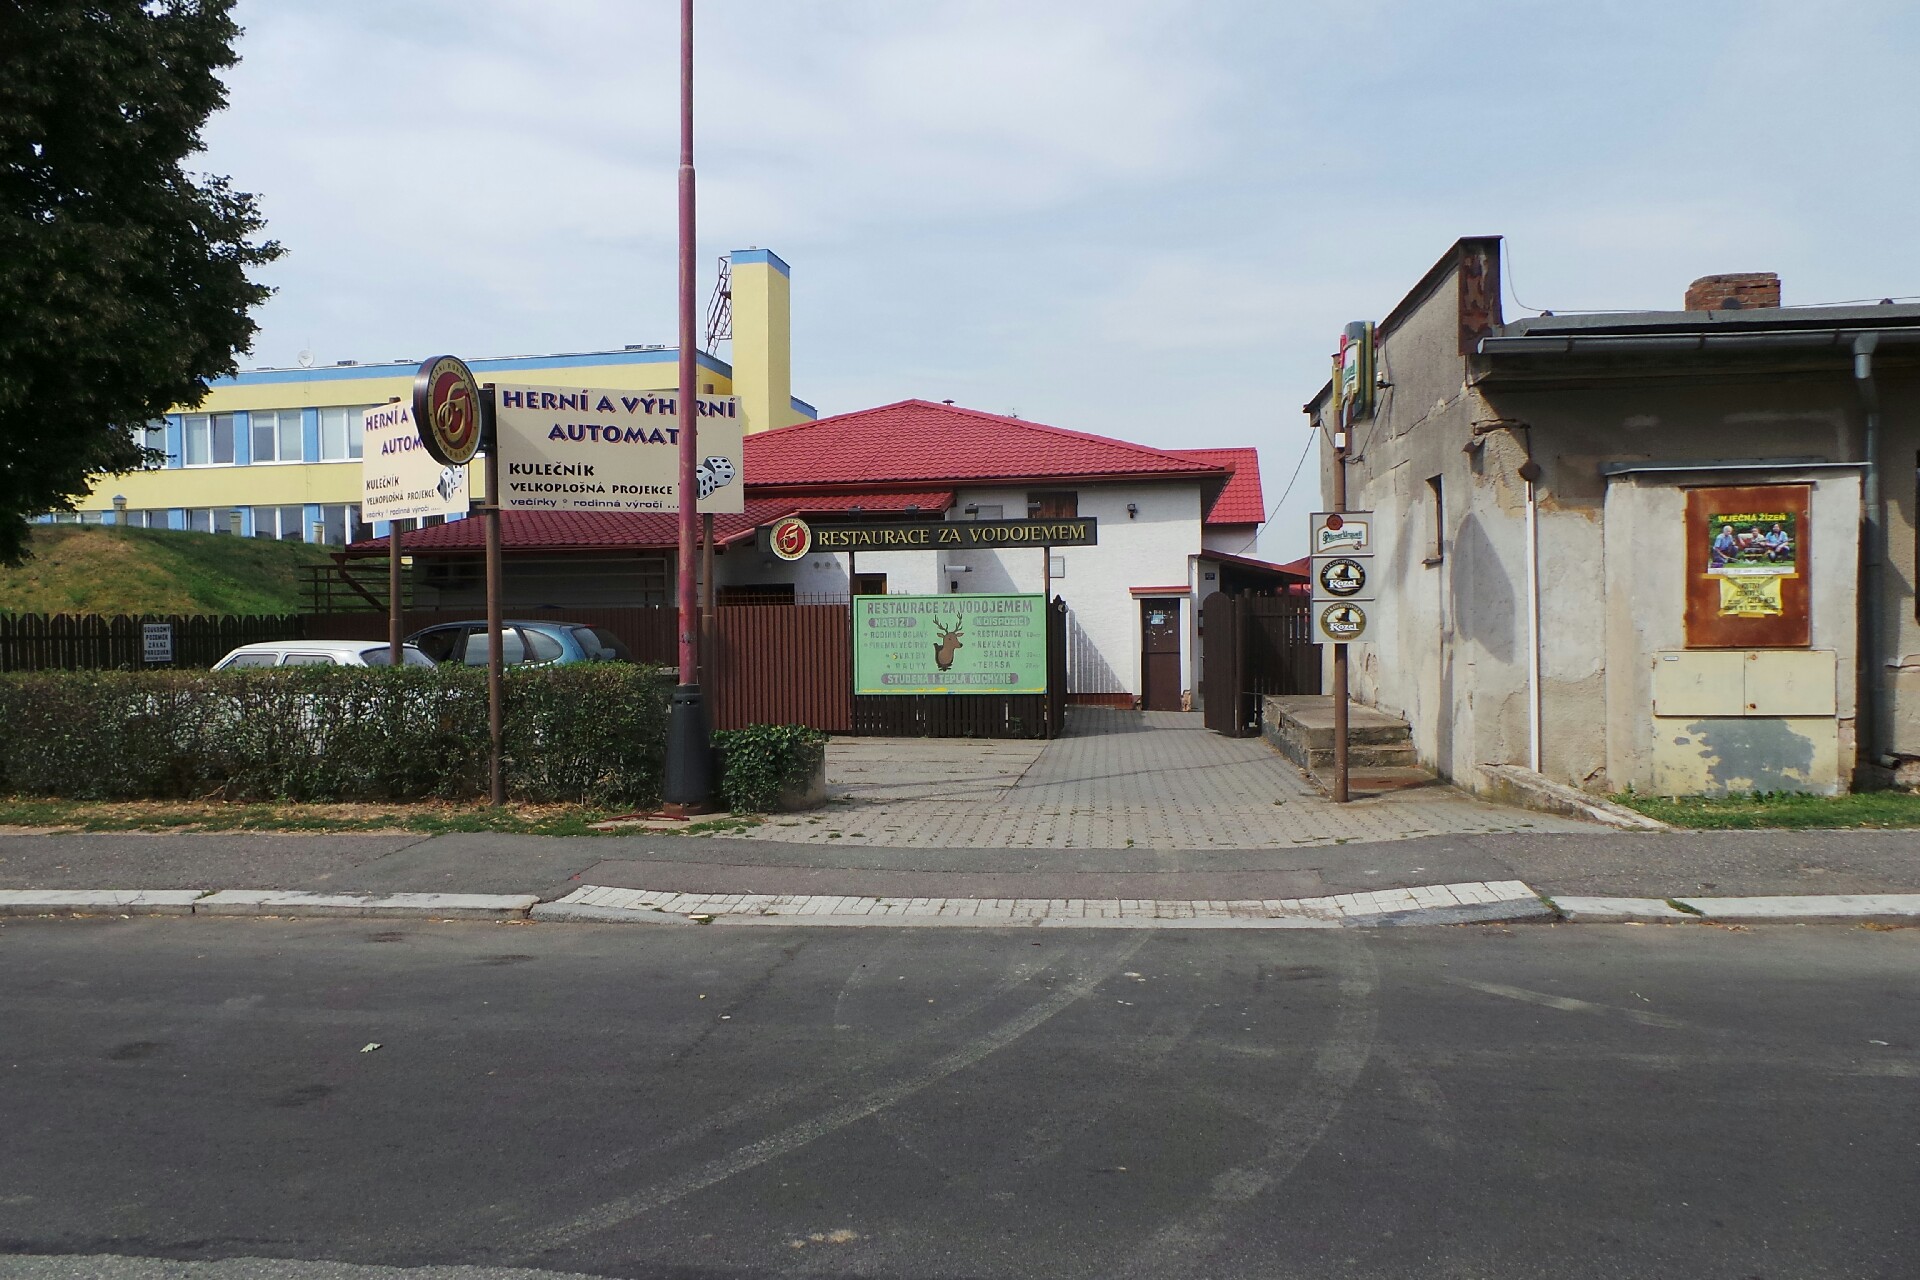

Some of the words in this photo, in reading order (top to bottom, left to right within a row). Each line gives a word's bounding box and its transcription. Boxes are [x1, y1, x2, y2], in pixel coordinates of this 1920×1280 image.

[503, 389, 589, 412] HERNÍ
[595, 395, 616, 413] A
[621, 393, 736, 418] VÝHRNÍ
[366, 405, 398, 432] HERNÍ
[401, 408, 409, 424] A
[548, 423, 698, 445] AUTOMAT
[509, 461, 595, 476] KULEČNÍK
[366, 475, 400, 491] KULEČNÍK
[510, 482, 606, 494] VELKOPLOŠNÁ
[612, 484, 673, 495] PROJEKCE
[366, 491, 404, 506] VELKOPLOŠNÁ
[407, 489, 434, 501] PROJEKCE
[510, 498, 557, 508] večírky
[573, 500, 621, 508] rodinná
[626, 500, 664, 510] výročí
[818, 529, 930, 546] RESTAURACE
[938, 528, 961, 543] ZA
[968, 524, 1086, 542] VODOJEMEM
[1329, 579, 1360, 589] Kozel
[867, 602, 939, 615] RESTAURACE
[942, 600, 956, 613] ZA
[959, 600, 1033, 613] VODOJEMEM
[977, 630, 1022, 638] RESTAURACE
[1329, 622, 1360, 632] Kozel
